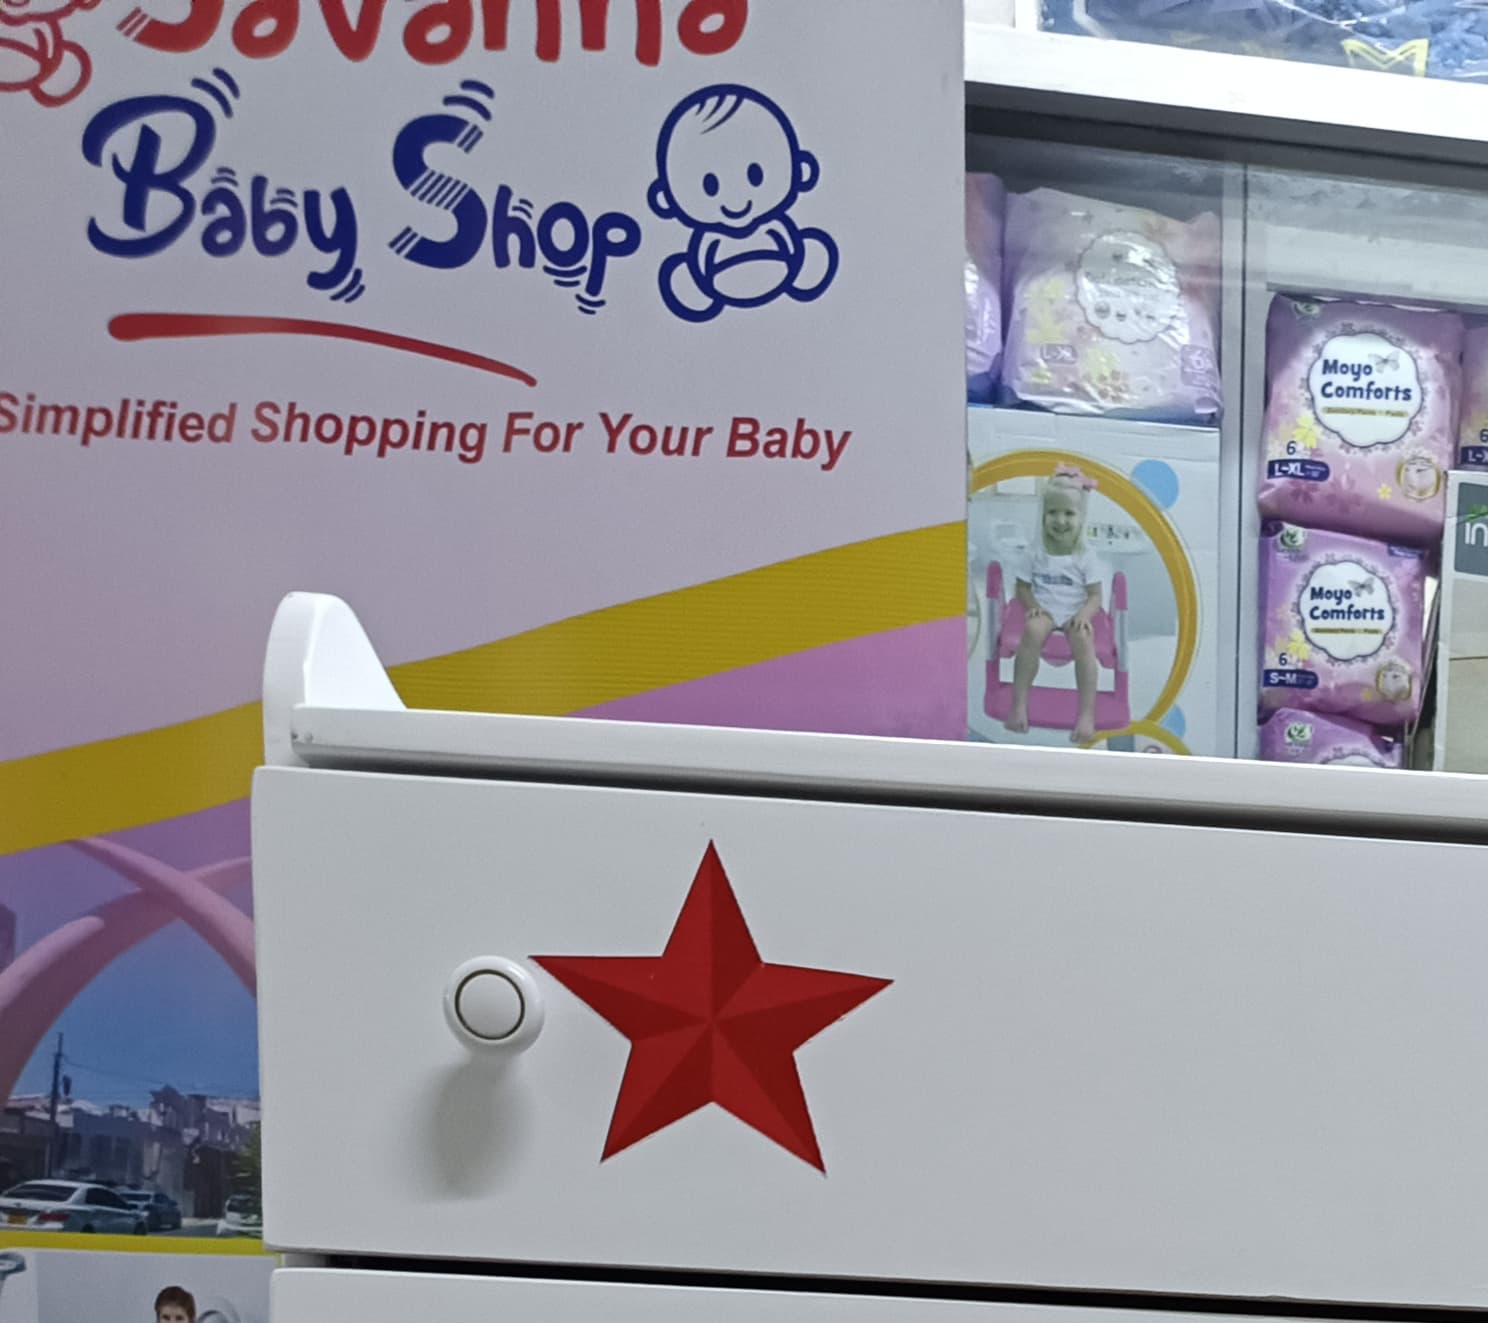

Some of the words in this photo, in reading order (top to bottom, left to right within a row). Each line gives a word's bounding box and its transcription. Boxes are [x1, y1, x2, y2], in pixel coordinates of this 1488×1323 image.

[82, 95, 358, 290] Baby
[390, 115, 641, 297] Shop
[1322, 359, 1373, 381] Moyo
[1321, 381, 1412, 401] Comforts
[0, 392, 237, 447] Simplified
[251, 401, 487, 464] Shopping
[502, 411, 584, 453] For
[600, 413, 713, 456] Your
[726, 416, 851, 471] Baby
[1286, 441, 1297, 455] 6
[1310, 586, 1352, 605] Moyo
[1309, 604, 1385, 620] Comforts
[1278, 653, 1287, 666] 6
